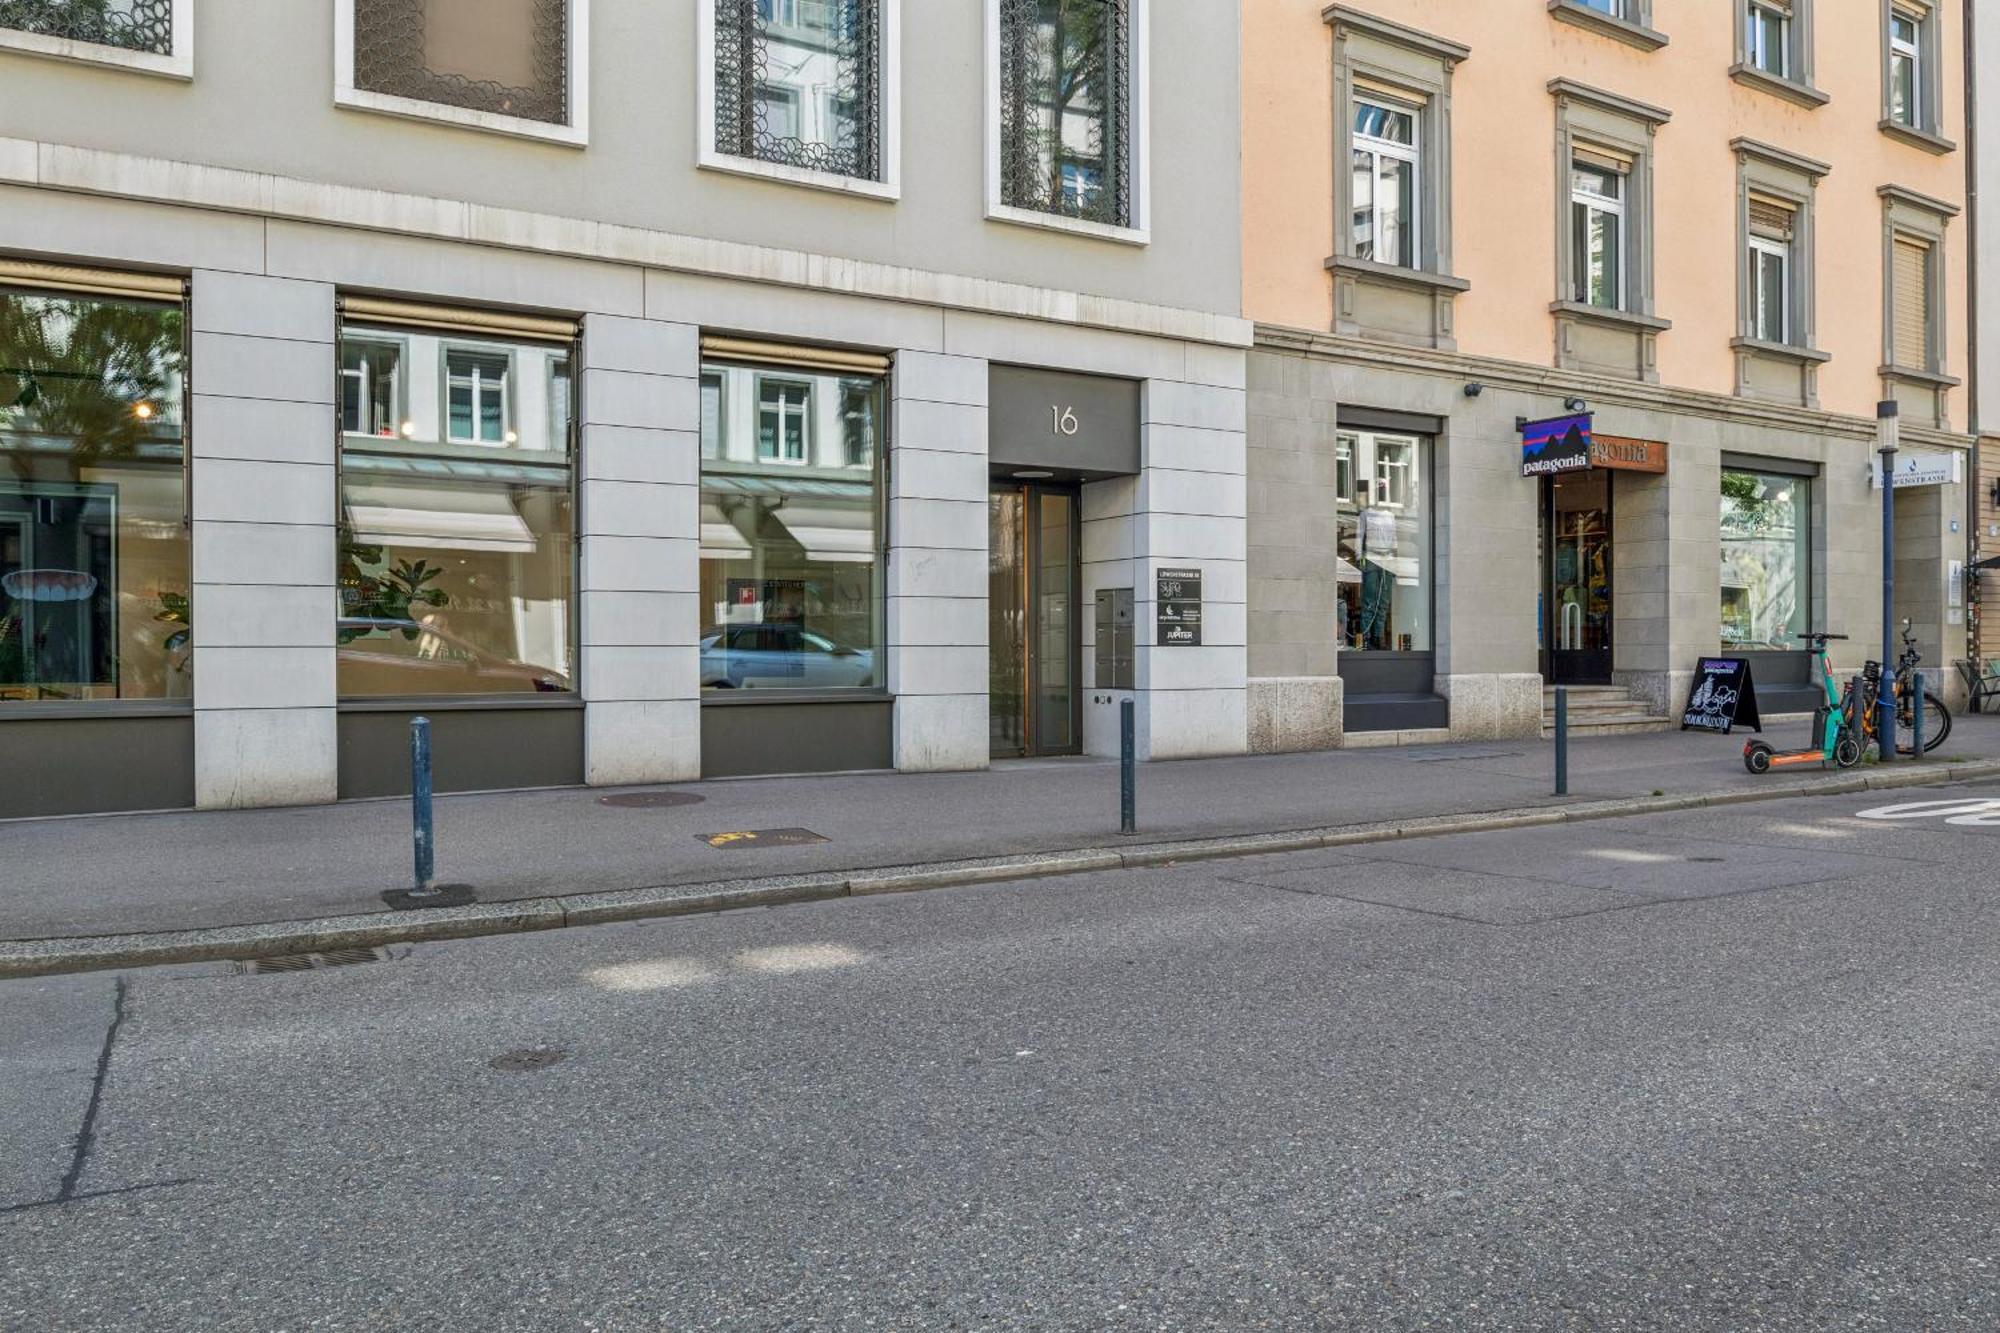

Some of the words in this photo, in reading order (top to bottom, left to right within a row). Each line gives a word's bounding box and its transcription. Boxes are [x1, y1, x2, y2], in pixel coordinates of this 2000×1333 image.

[1052, 405, 1078, 435] 16
[1523, 453, 1586, 475] patagonia
[1591, 440, 1648, 464] agonia
